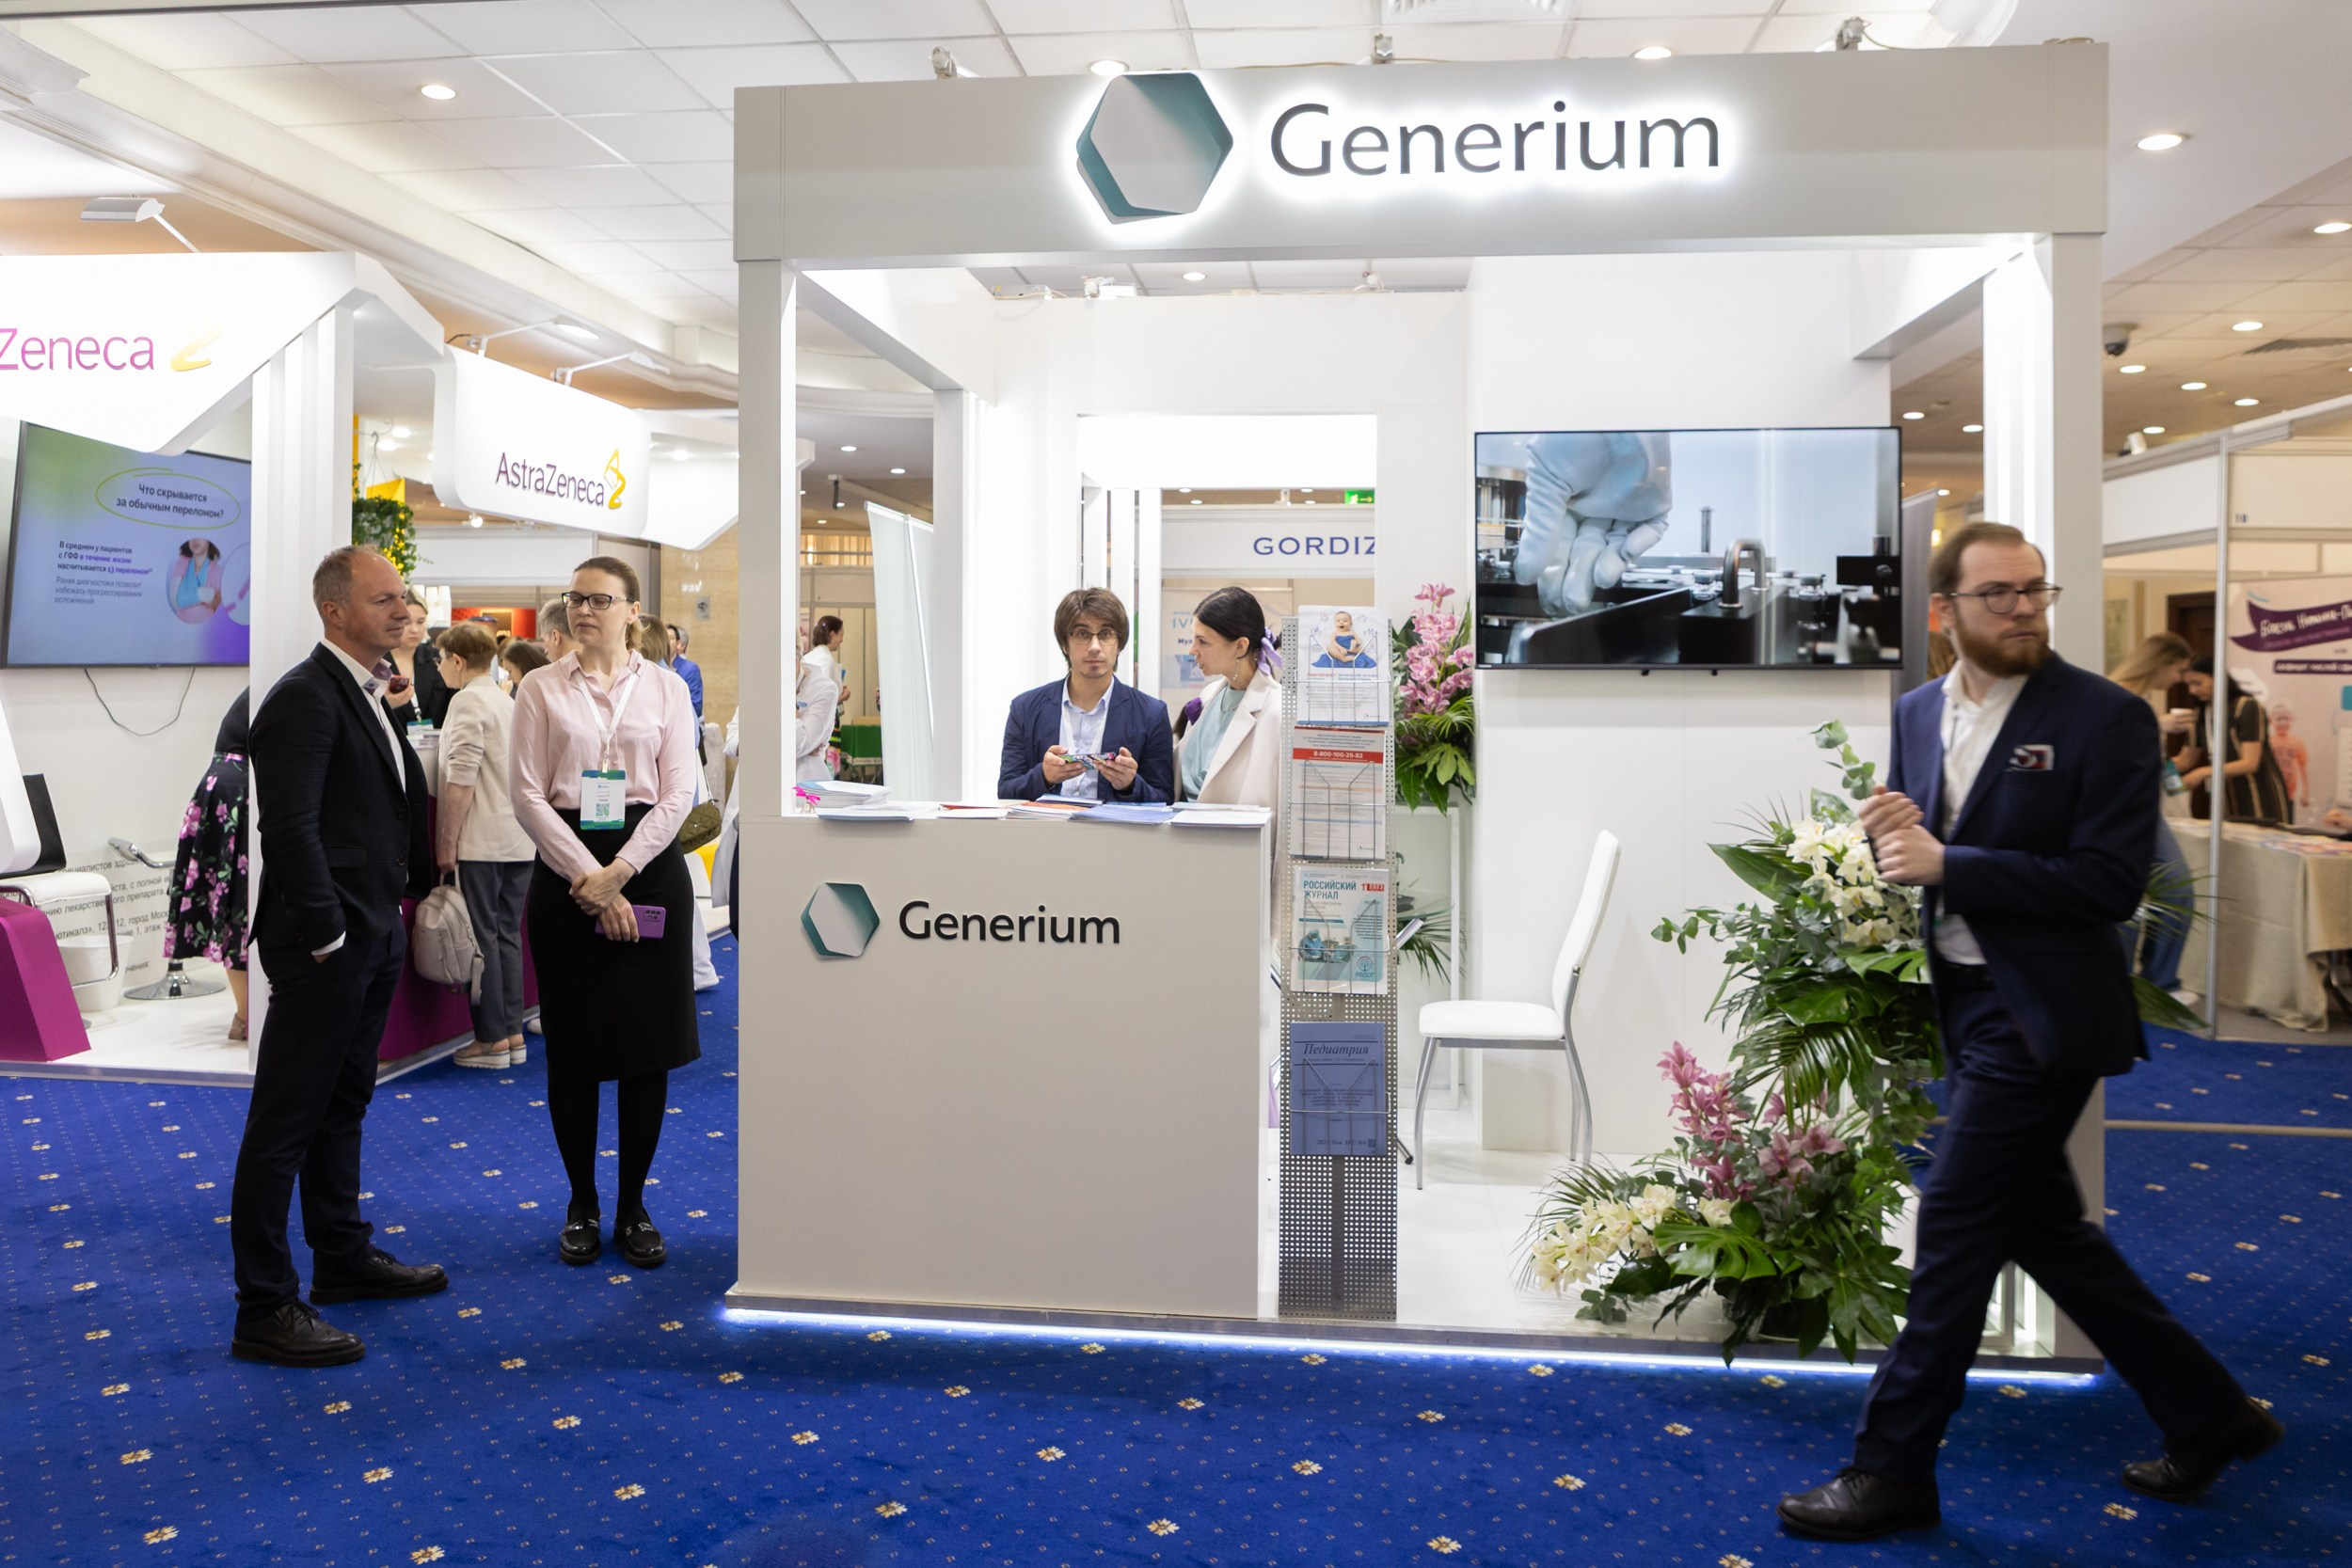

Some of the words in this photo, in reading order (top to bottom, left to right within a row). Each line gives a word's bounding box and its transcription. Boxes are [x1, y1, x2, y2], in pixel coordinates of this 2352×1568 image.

[1270, 100, 1721, 177] Generium
[0, 327, 154, 371] Zeneca
[495, 451, 605, 507] AstraZeneca
[138, 483, 155, 495] Что
[156, 488, 207, 502] скрывается
[116, 498, 127, 507] за
[129, 499, 171, 513] обычным
[172, 505, 225, 519] переломом?
[59, 540, 65, 548] В
[65, 542, 94, 551] среднем
[100, 545, 133, 554] пациентов
[57, 562, 107, 573] насчитывается
[136, 875, 162, 888] полной
[1303, 879, 1357, 891] РОССИЙСКИЙ
[1304, 890, 1339, 900] ЖУРНАЛ
[128, 913, 150, 926] город
[898, 900, 1120, 944] Generium
[1303, 1043, 1370, 1057] Педиатрия
